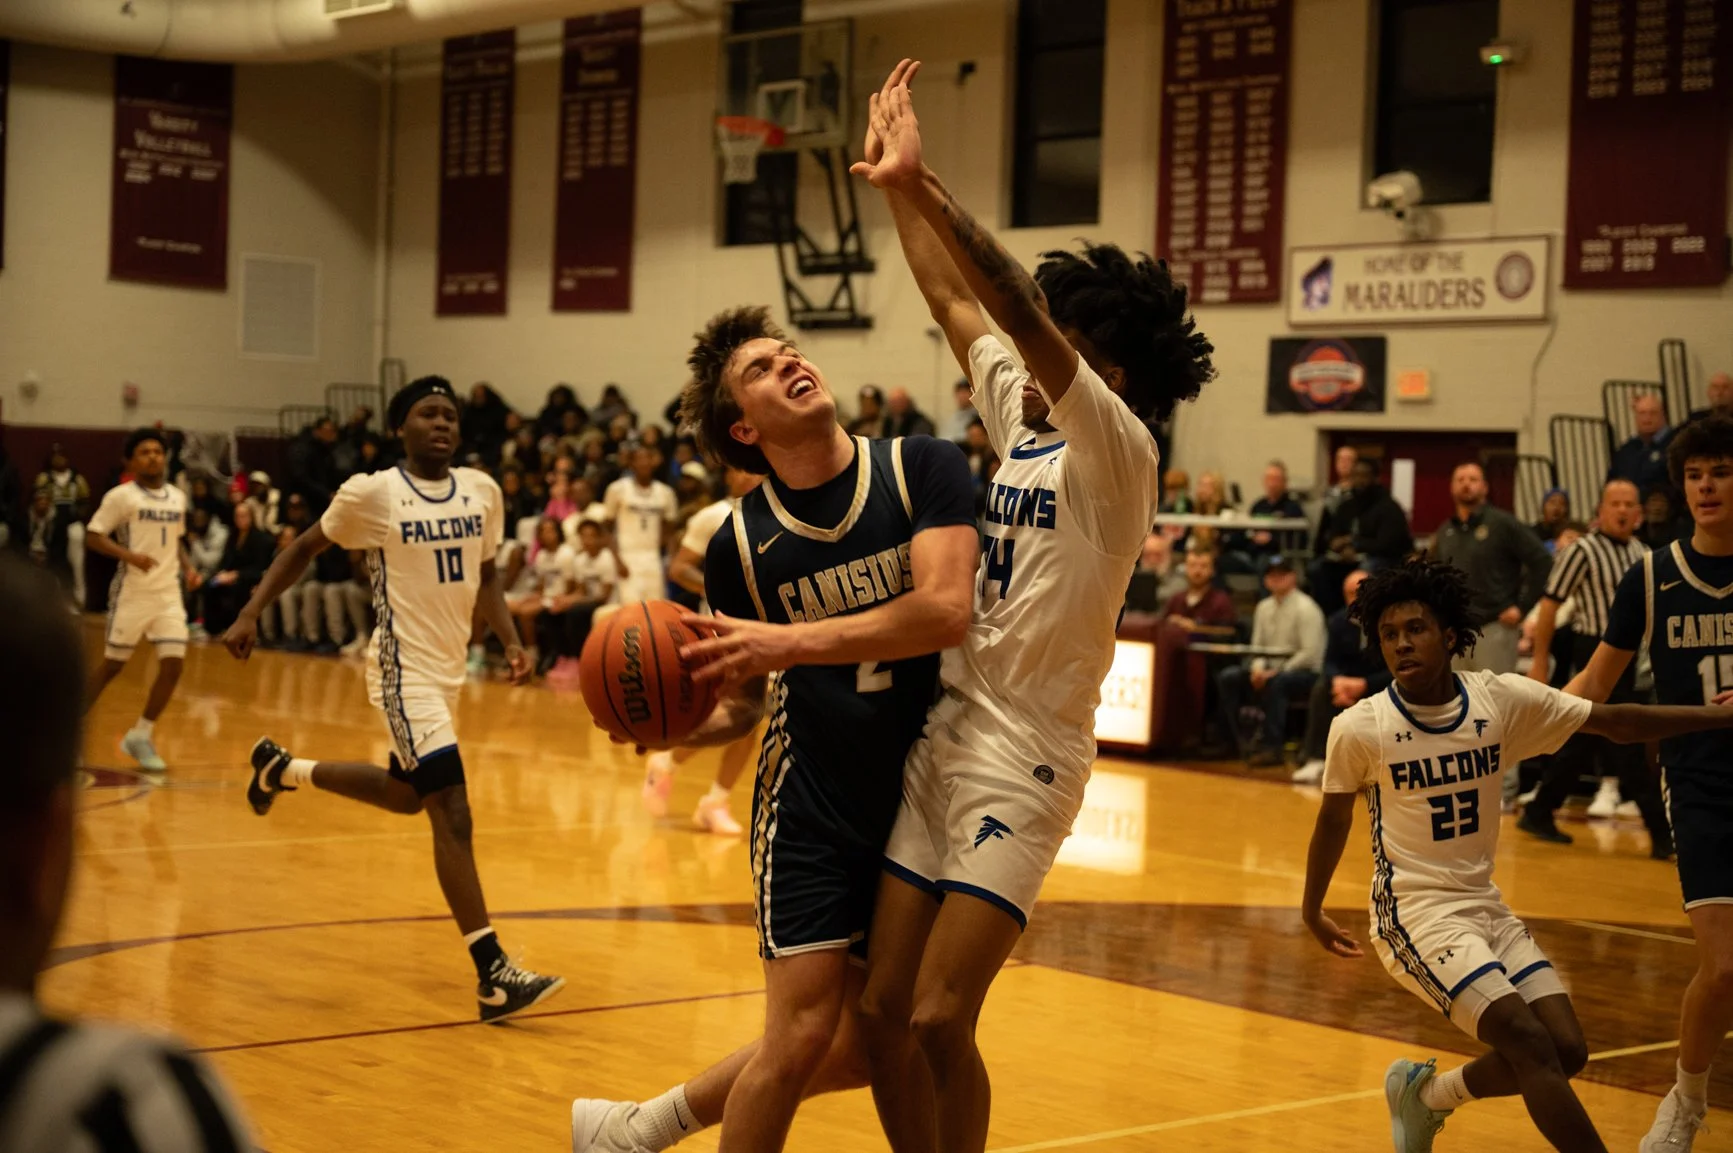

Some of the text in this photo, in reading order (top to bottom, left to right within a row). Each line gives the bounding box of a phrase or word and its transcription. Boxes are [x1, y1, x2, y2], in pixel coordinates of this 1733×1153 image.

[1363, 250, 1463, 275] HOME OF THE
[1344, 277, 1486, 311] MARAUDERS
[400, 514, 482, 545] FALCONS
[984, 482, 1057, 530] LCONS
[434, 547, 465, 584] 10
[777, 541, 914, 625] CANISIUS
[617, 623, 652, 724] Wilson
[1388, 742, 1501, 790] FALCONS
[1426, 787, 1480, 842] 23
